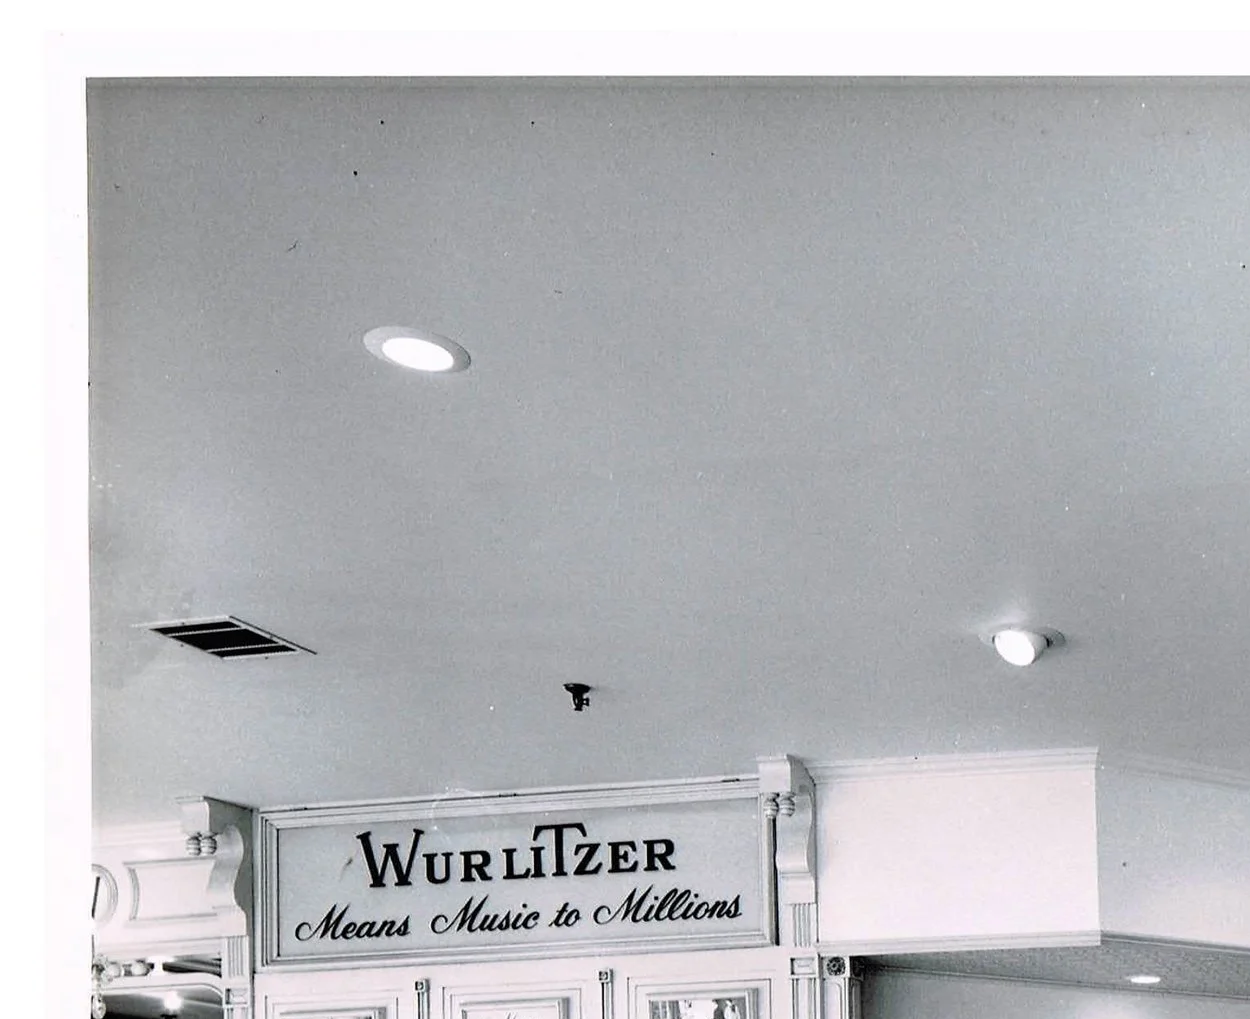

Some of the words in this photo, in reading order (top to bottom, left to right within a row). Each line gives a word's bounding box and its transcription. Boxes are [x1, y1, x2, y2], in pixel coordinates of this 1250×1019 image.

[294, 903, 411, 942] Means
[430, 894, 540, 935] Music
[548, 901, 582, 928] to
[592, 884, 743, 925] Millions
